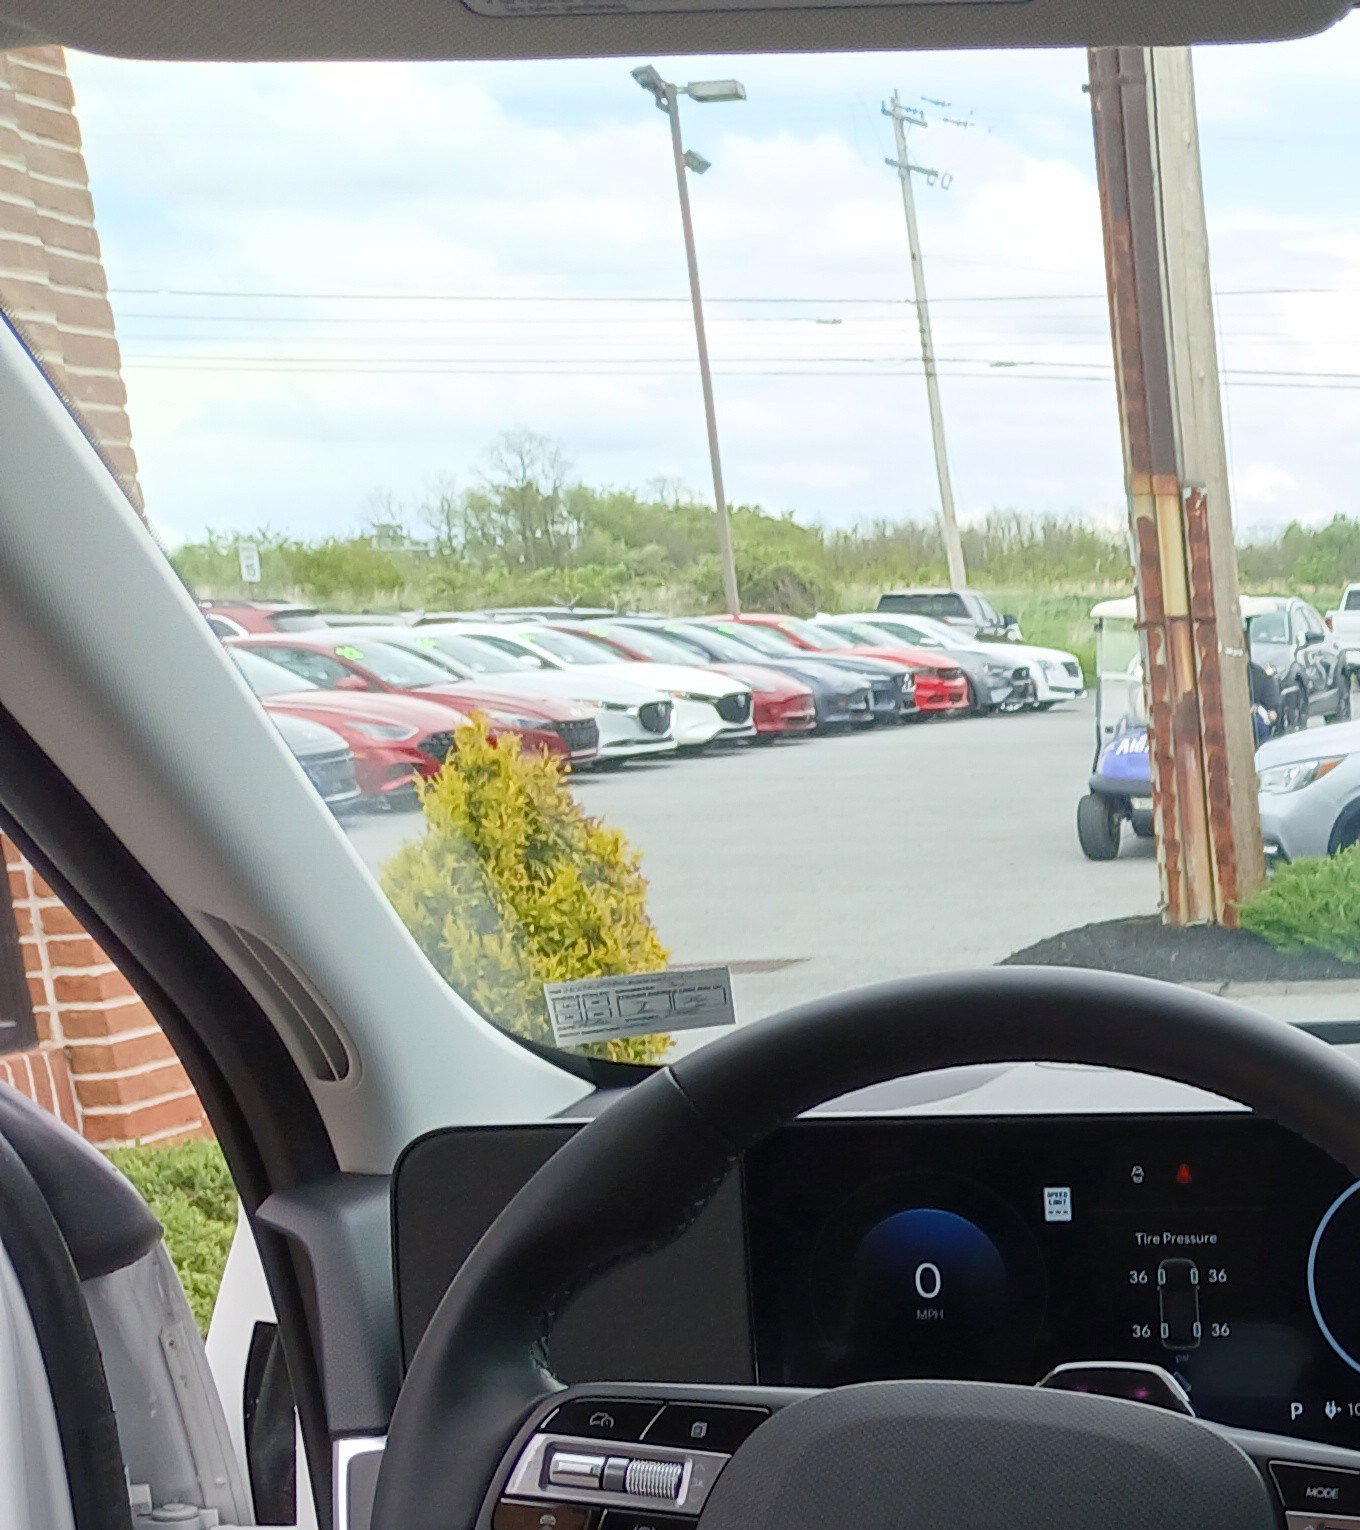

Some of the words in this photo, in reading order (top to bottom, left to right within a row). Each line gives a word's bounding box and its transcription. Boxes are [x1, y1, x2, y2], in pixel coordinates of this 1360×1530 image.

[1134, 1232, 1160, 1246] Tire
[1162, 1232, 1218, 1246] Pressure
[915, 1262, 941, 1298] 0
[1128, 1270, 1148, 1284] 36
[1208, 1268, 1228, 1283] 36
[916, 1308, 944, 1320] MPH
[1132, 1324, 1151, 1338] 36
[1211, 1322, 1230, 1337] 36
[1290, 1402, 1304, 1420] P
[1306, 1486, 1339, 1500] MODE
